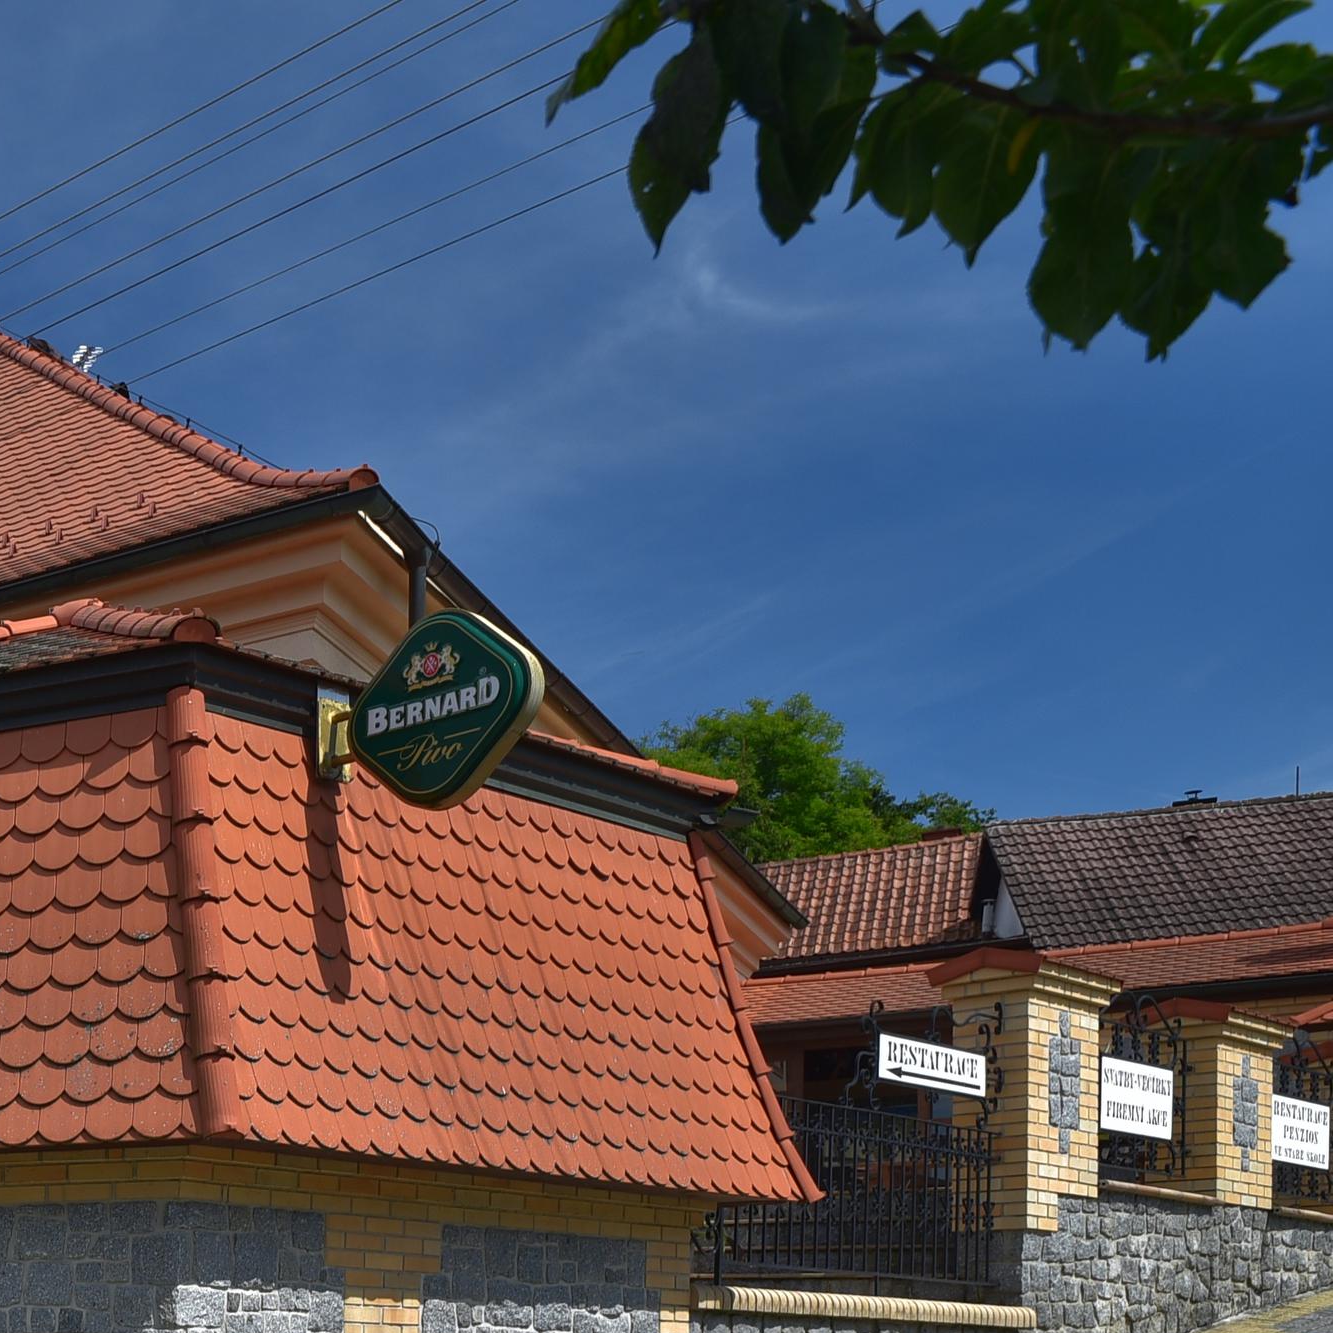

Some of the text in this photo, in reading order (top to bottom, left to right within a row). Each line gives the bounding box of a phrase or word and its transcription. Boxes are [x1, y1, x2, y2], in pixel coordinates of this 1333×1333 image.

[367, 675, 501, 736] BERNARD
[397, 735, 464, 771] Pivo
[887, 1041, 978, 1079] RESTAURACE
[1146, 1108, 1168, 1127] AKCE
[1274, 1100, 1328, 1126] RESTAURACE
[1283, 1124, 1319, 1145] PENZION
